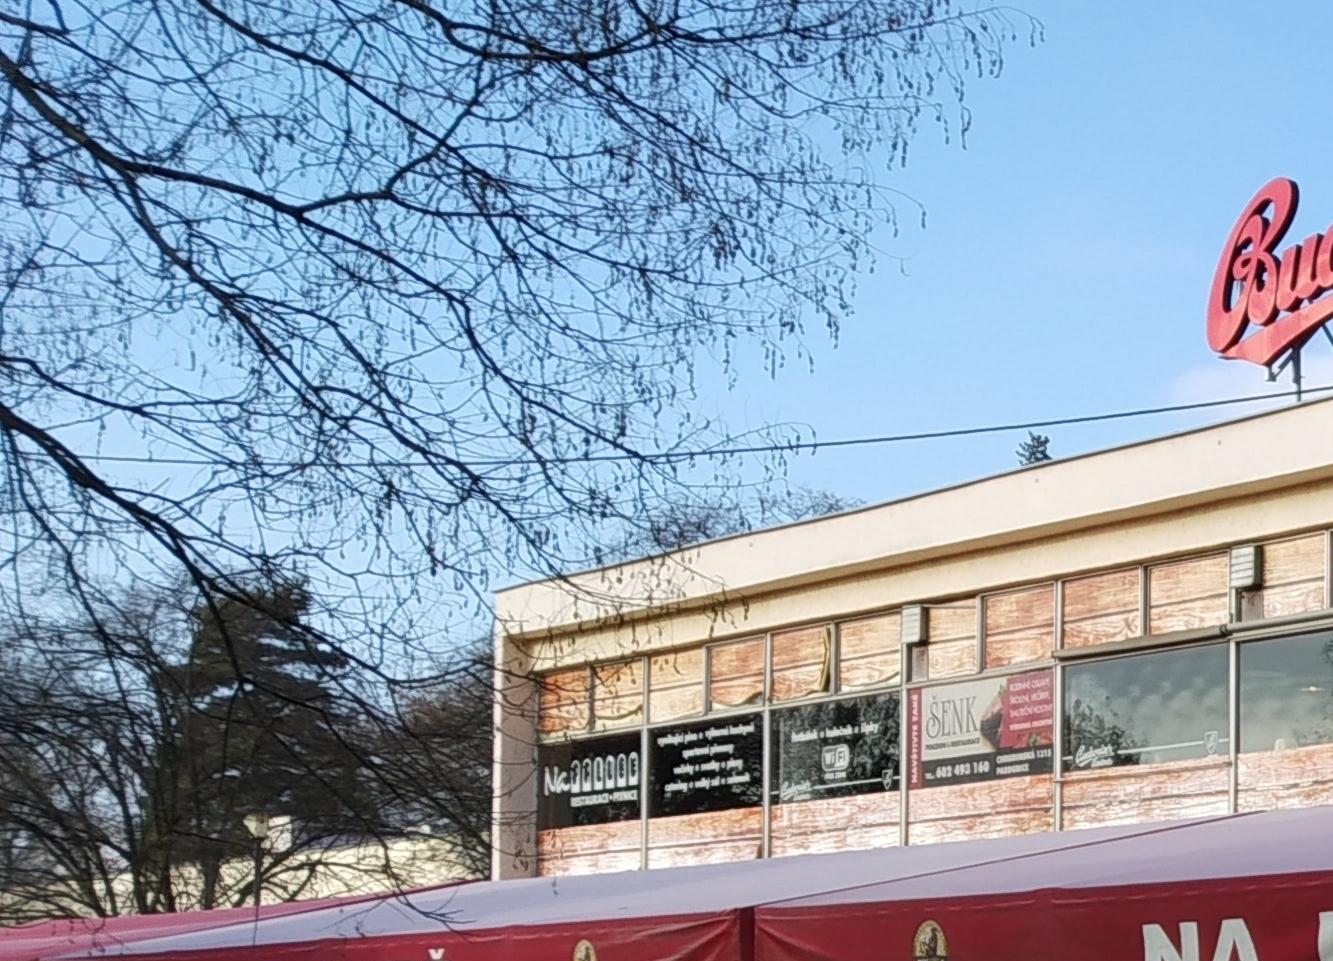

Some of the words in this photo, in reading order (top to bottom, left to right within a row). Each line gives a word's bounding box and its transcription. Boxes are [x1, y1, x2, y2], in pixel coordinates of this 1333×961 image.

[925, 693, 979, 739] ŠENK
[544, 766, 570, 796] Na
[936, 765, 952, 778] 602
[954, 763, 970, 776] 493
